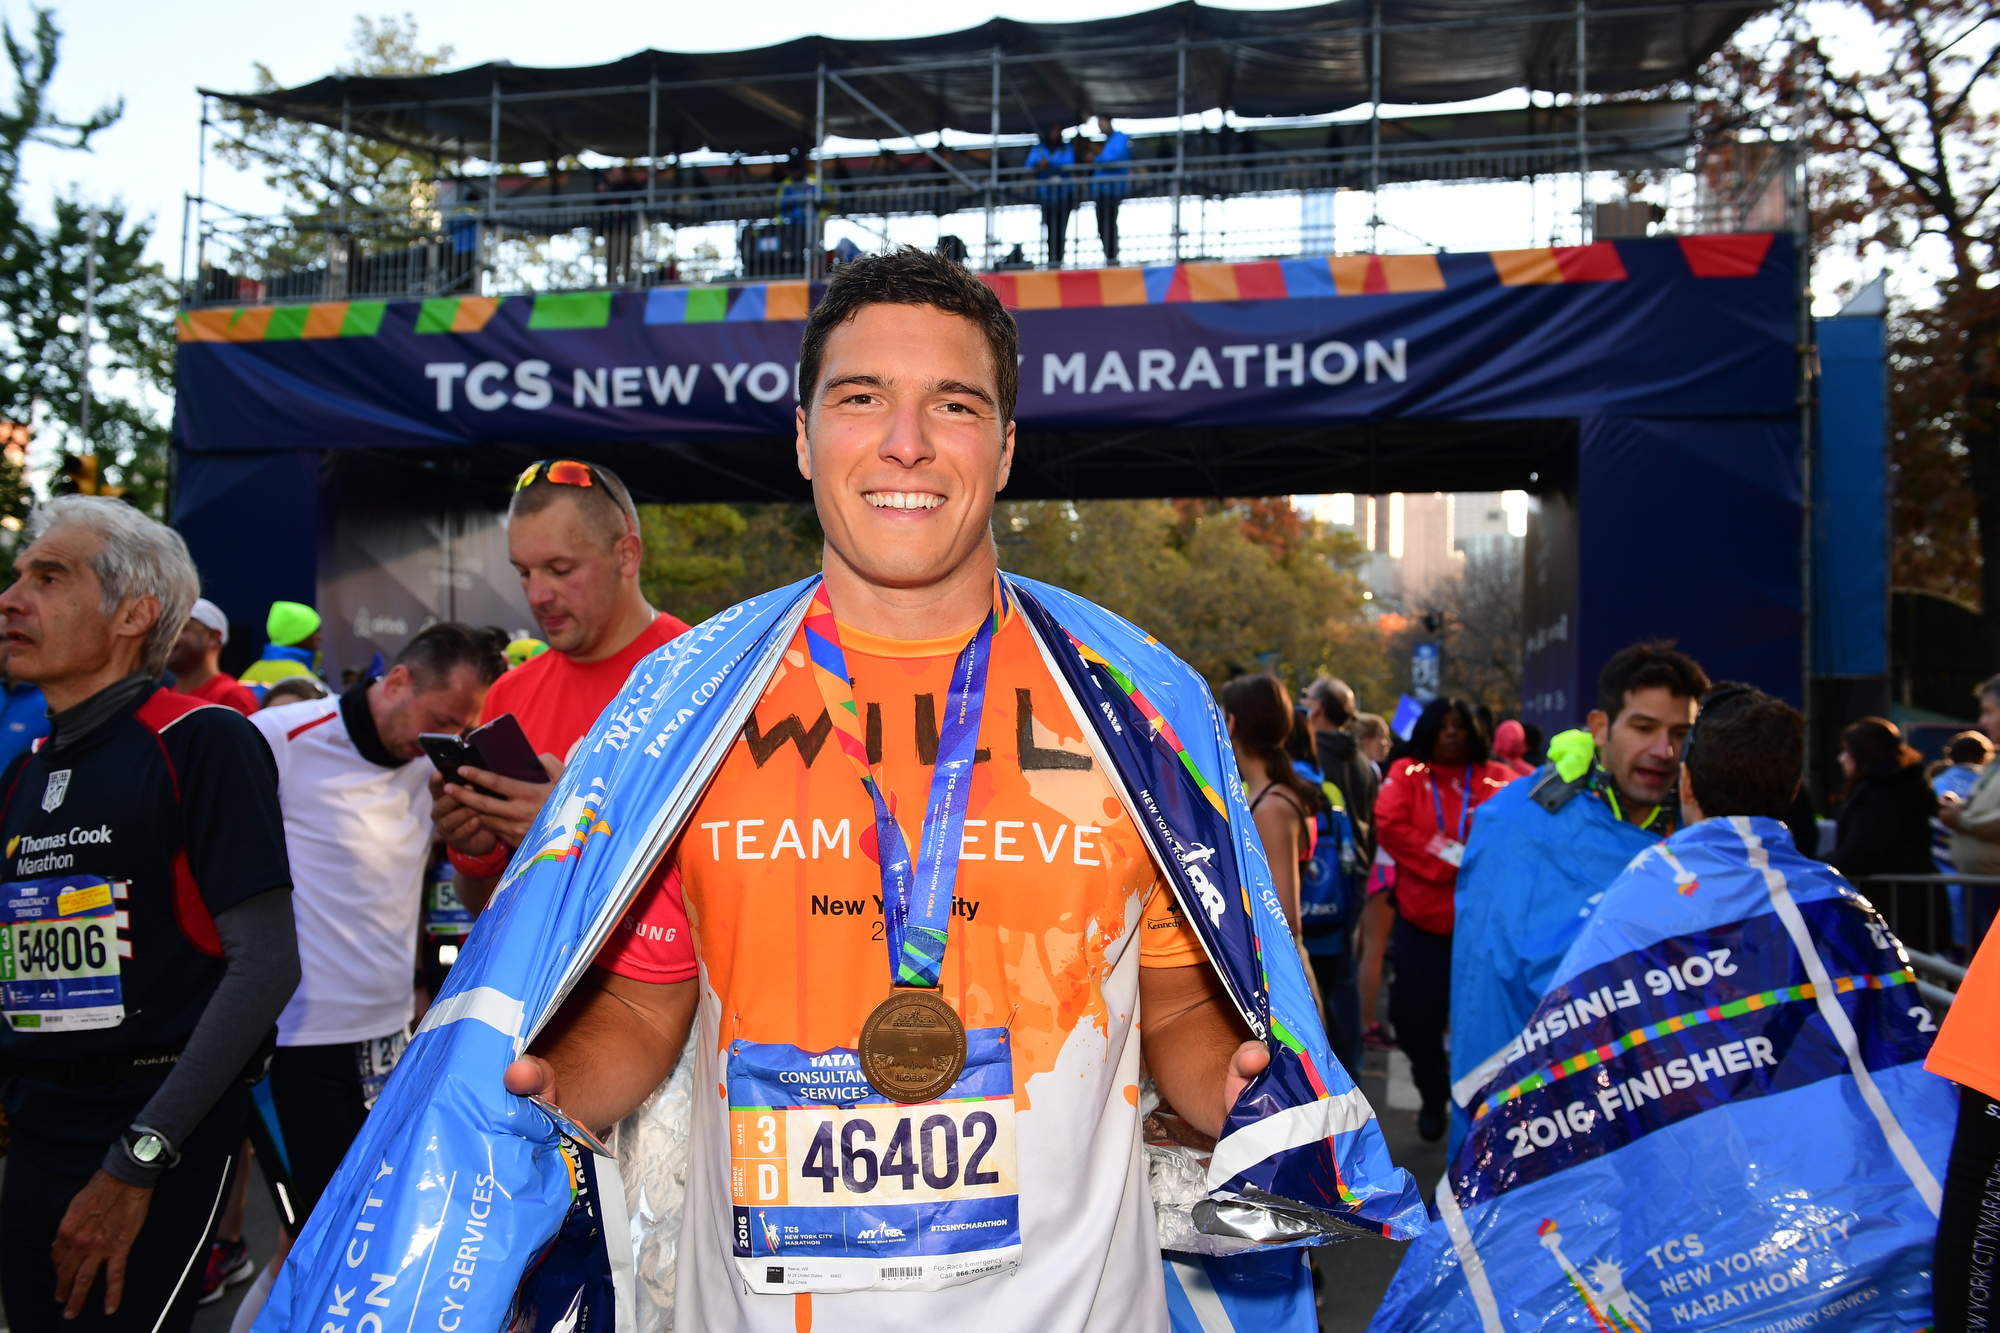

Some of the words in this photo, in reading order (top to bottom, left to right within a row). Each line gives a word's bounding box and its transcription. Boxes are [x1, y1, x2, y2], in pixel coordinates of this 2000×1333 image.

[424, 359, 553, 412] TCS
[573, 364, 700, 408] NEW
[712, 361, 801, 403] YO
[1042, 338, 1407, 395] MARATHON
[963, 660, 974, 699] MARATHON
[644, 708, 694, 759] TATA
[745, 687, 1093, 772] WILL
[947, 772, 957, 790] TCS
[945, 791, 953, 809] NEW
[1140, 789, 1160, 816] NEW
[1156, 814, 1175, 846] YORK
[941, 809, 949, 830] YORK
[21, 833, 67, 854] Thomas
[68, 824, 113, 845] Cook
[700, 818, 851, 862] TEAM
[921, 819, 1101, 867] EEVE
[938, 830, 946, 850] CITY
[16, 852, 74, 876] Marathon
[931, 850, 943, 891] MARATHON
[897, 874, 905, 894] TCS
[811, 895, 866, 916] New
[951, 895, 980, 922] ity
[900, 894, 908, 913] NEW
[1, 927, 10, 951] 3
[1147, 918, 1182, 930] Kennedy
[3, 956, 12, 978] F
[18, 924, 107, 973] 54806
[1643, 948, 1738, 997] 2016
[778, 1069, 867, 1085] CONSULTAN
[809, 1053, 856, 1067] TATA
[800, 1086, 869, 1100] SERVICES
[1505, 1100, 1596, 1159] 2016
[1597, 1035, 1778, 1122] FINISHER
[757, 1115, 777, 1153] 3
[801, 1110, 1000, 1194] 46402
[757, 1164, 779, 1201] D
[346, 1156, 393, 1269] CITY
[930, 1219, 1008, 1232] #TCSNYCMARATHON
[449, 1172, 495, 1292] SERVICES
[738, 1216, 749, 1248] 2016
[1972, 1229, 1998, 1267] CITY
[1646, 1233, 1705, 1271] TCS
[1659, 1263, 1712, 1297] NEW
[1716, 1241, 1788, 1277] YORK
[1791, 1216, 1851, 1255] CITY
[1671, 1264, 1810, 1325] MARATHON
[1820, 1286, 1879, 1319] SERVICES
[1967, 1264, 1992, 1310] YORK
